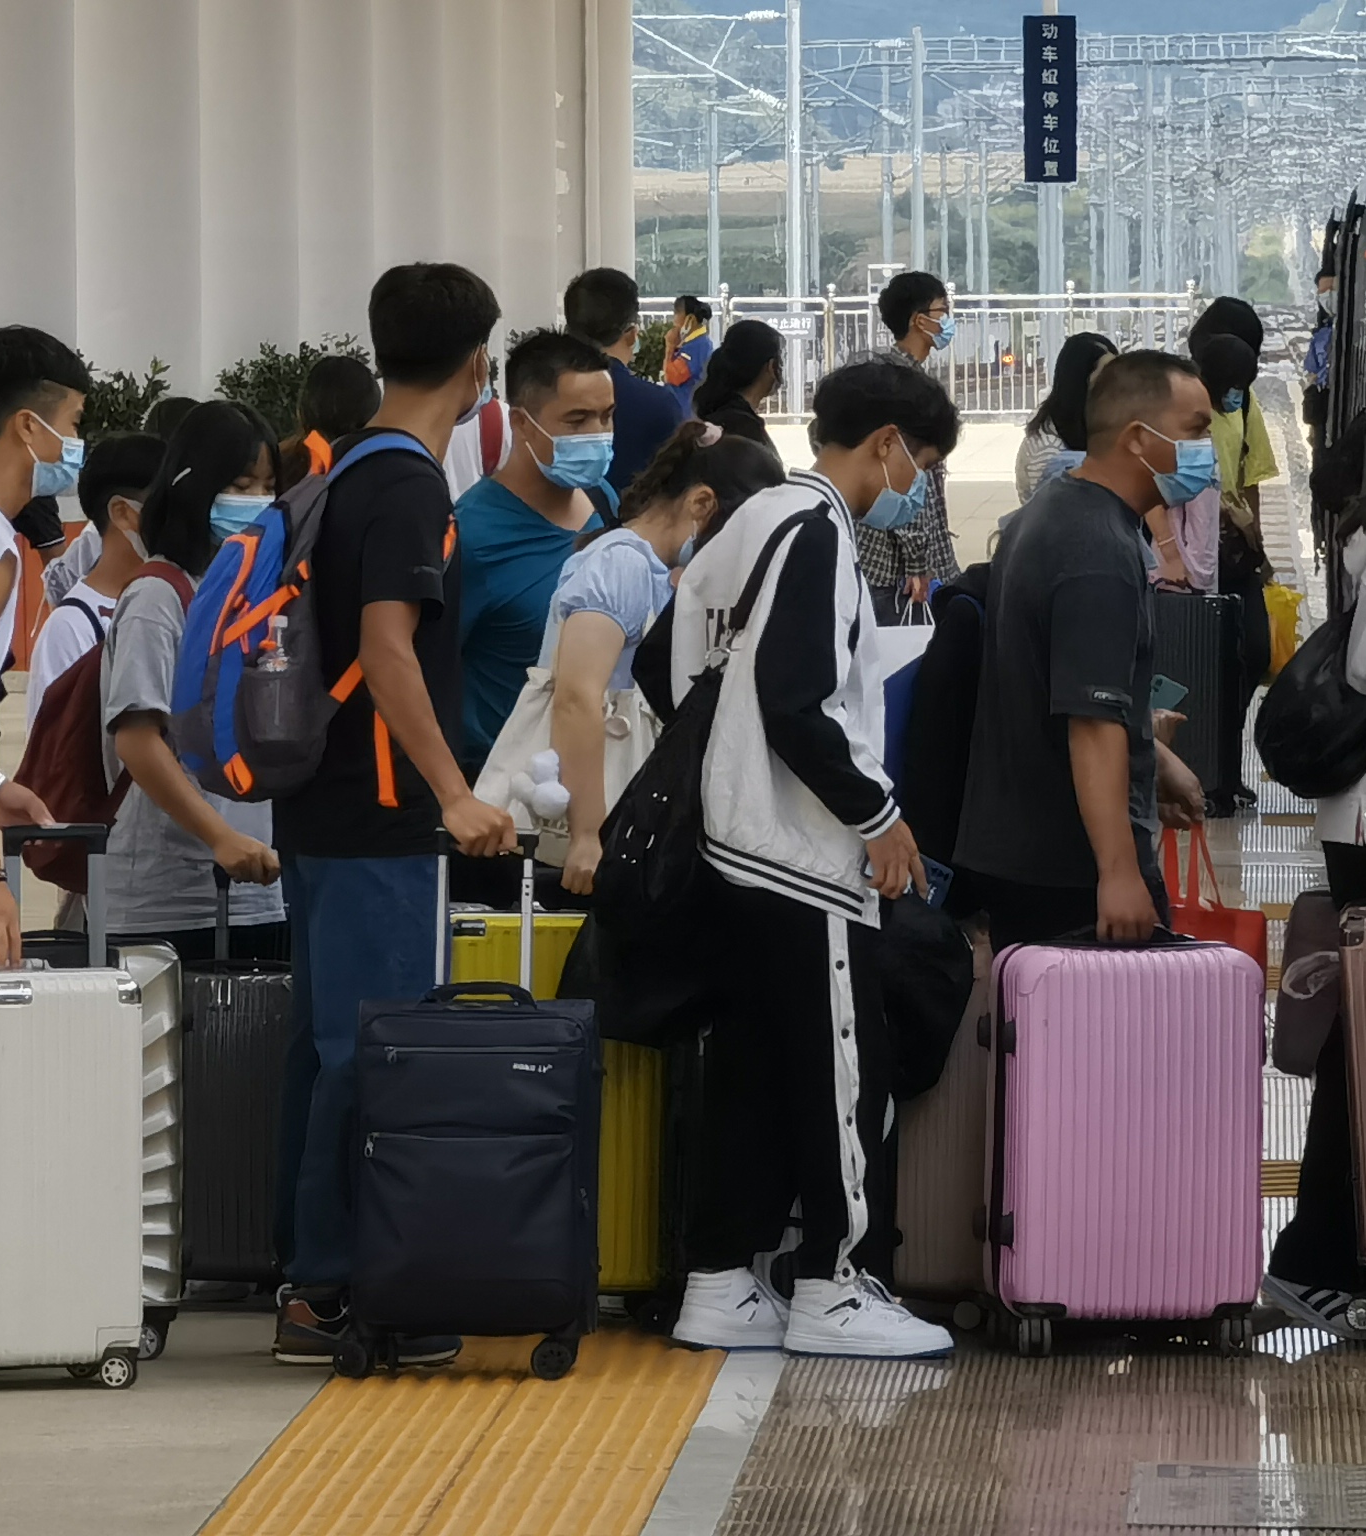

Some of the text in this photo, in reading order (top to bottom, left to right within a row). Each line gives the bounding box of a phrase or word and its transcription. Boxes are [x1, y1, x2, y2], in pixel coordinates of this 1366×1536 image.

[1041, 23, 1060, 177] 动车组停车位置
